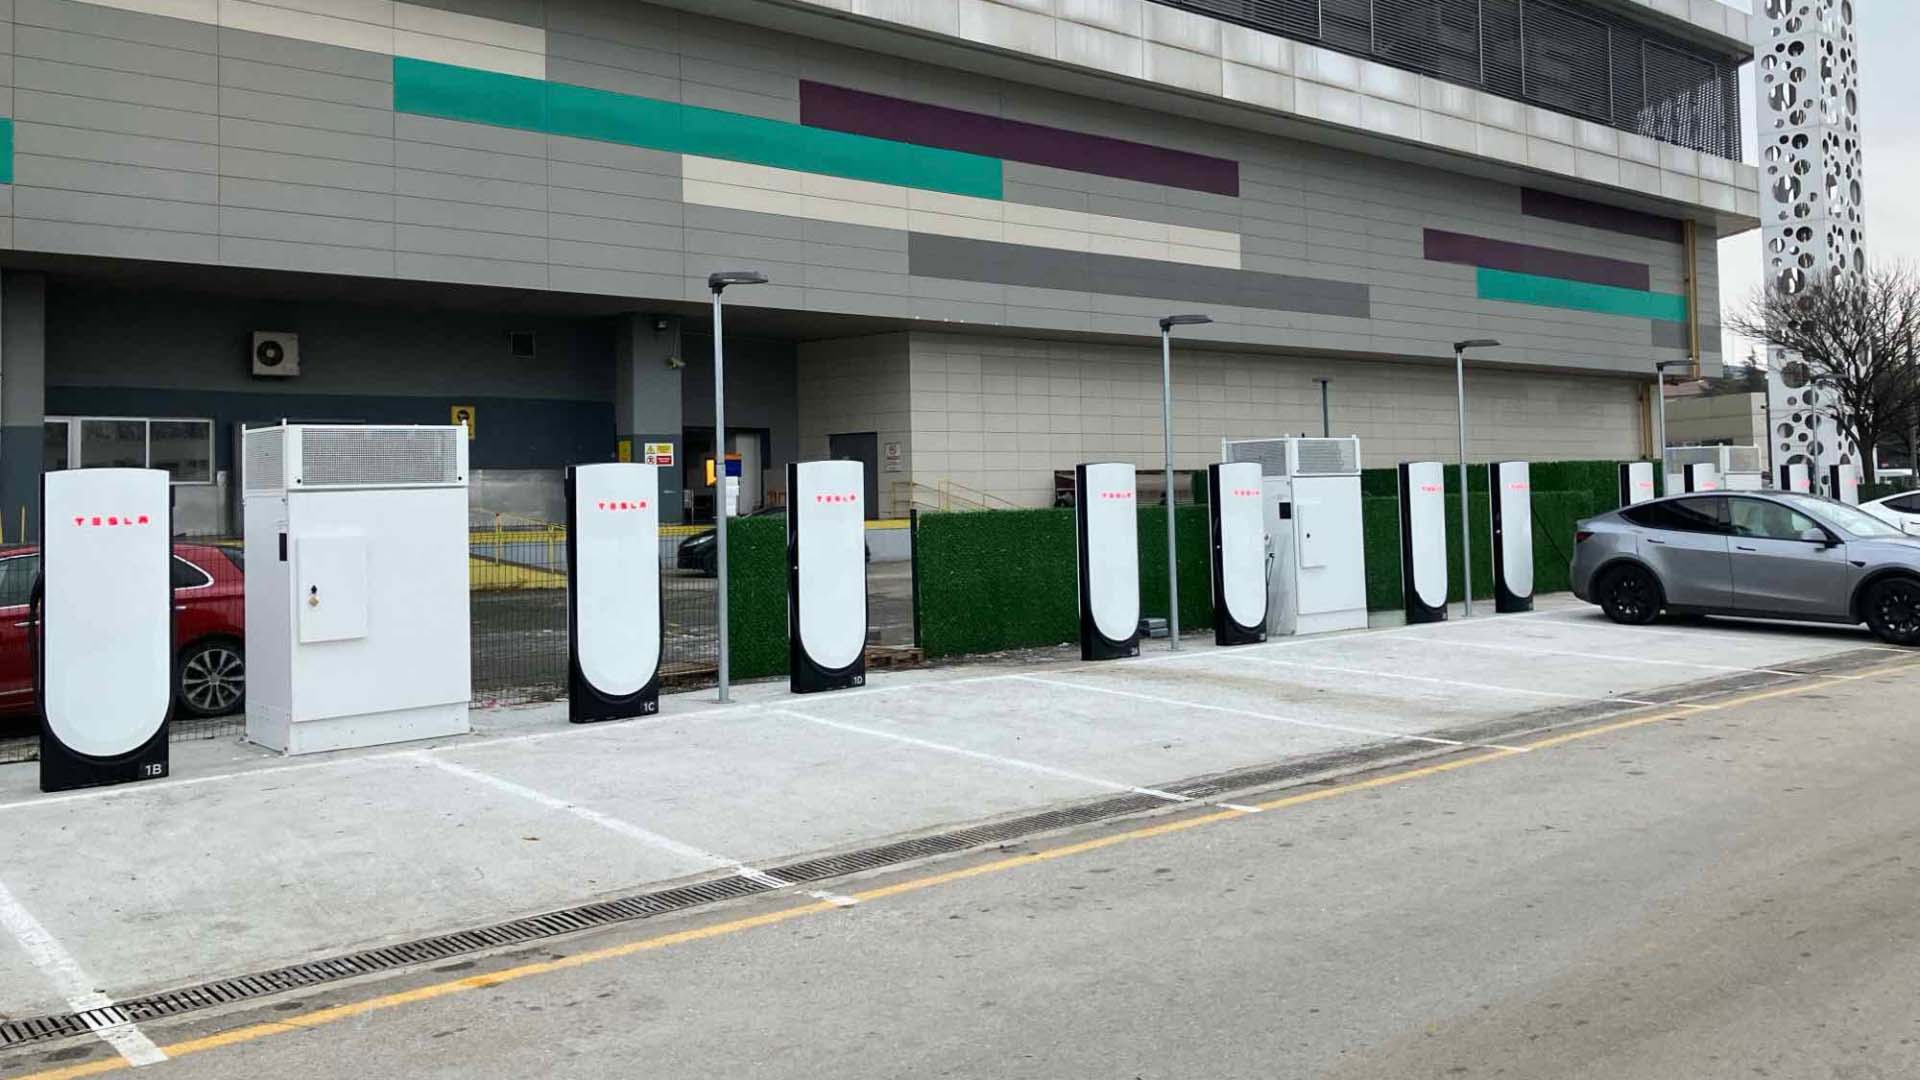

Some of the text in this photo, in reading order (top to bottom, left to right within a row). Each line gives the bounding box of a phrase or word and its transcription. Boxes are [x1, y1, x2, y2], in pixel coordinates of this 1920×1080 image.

[598, 501, 647, 510] TESLA
[75, 515, 149, 526] TESLA
[853, 676, 863, 685] 1D
[643, 702, 655, 712] 1C
[145, 763, 162, 776] 1B
